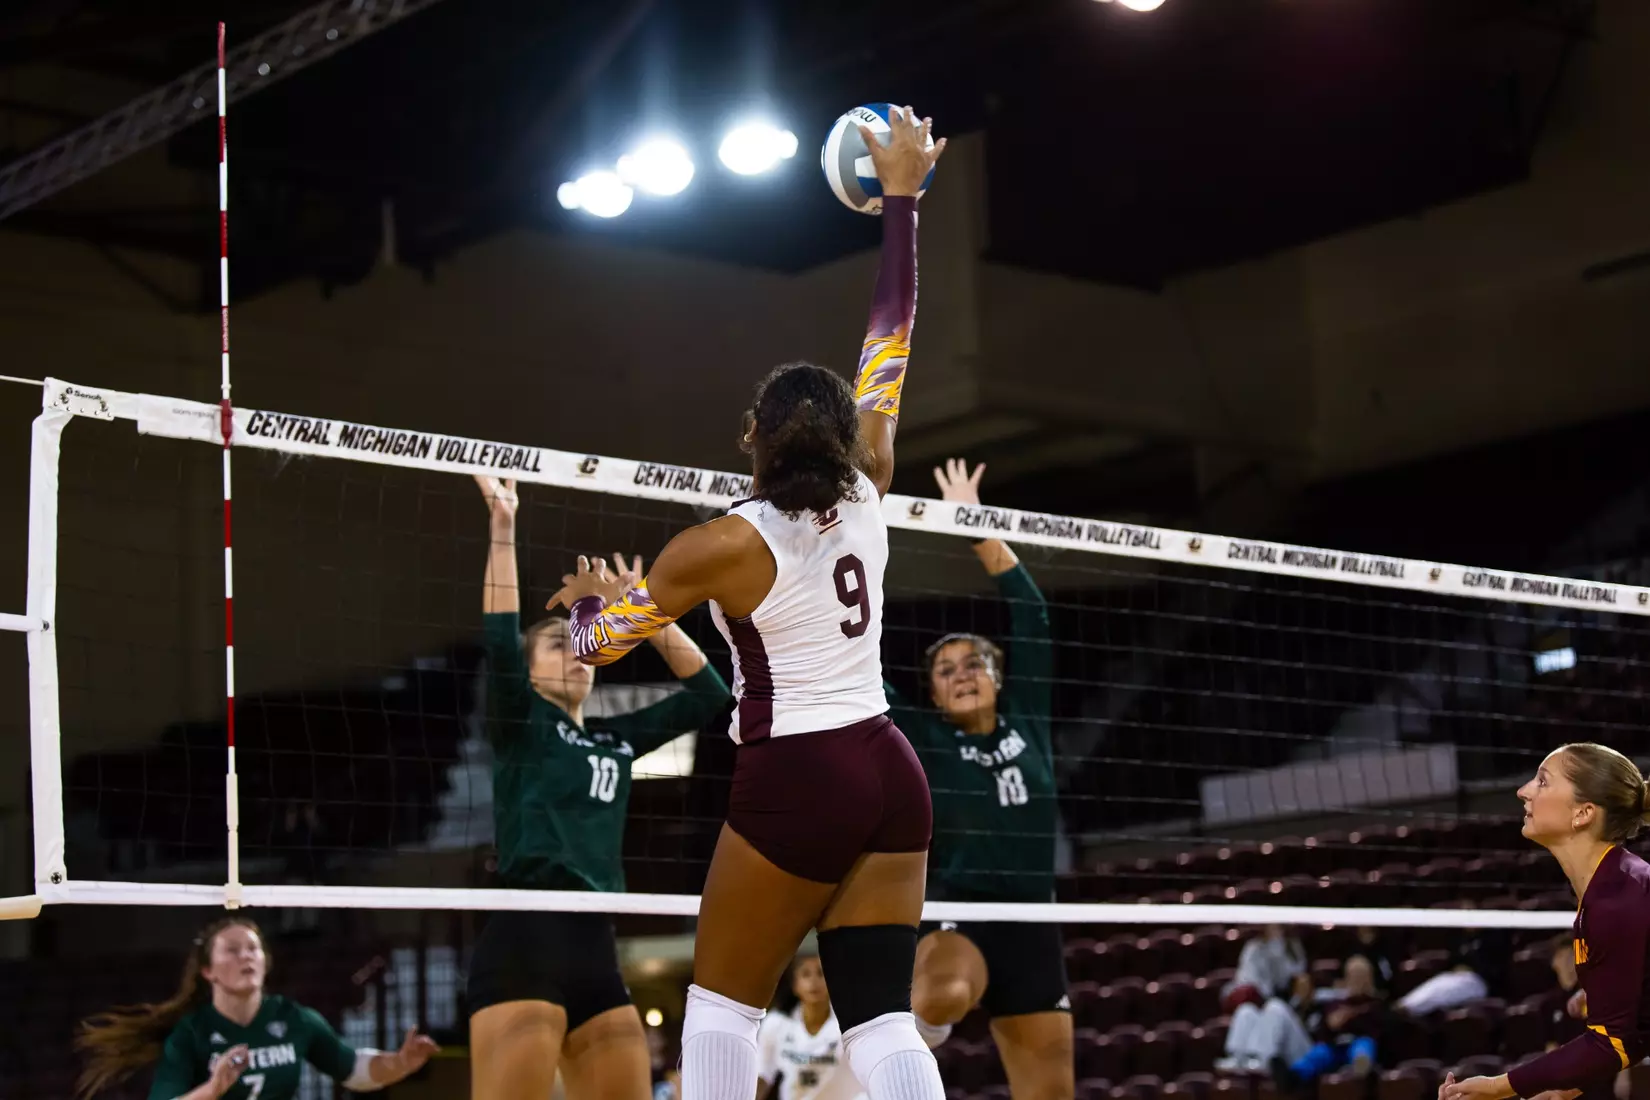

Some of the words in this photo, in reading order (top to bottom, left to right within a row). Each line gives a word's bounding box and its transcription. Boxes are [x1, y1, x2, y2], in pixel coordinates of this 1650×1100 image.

[246, 410, 332, 446] CENTRAL
[336, 423, 432, 459] MICHIGAN
[435, 438, 541, 473] VOLLEYBALL
[633, 463, 703, 492] CENTRAL
[707, 473, 754, 498] MICHI
[955, 506, 1012, 531] CENTRAL
[1018, 515, 1082, 539] MICHIGAN
[1086, 524, 1161, 550] VOLLEYBALL
[1228, 542, 1277, 564] CENTRAL
[1282, 549, 1337, 569] MICHIGAN
[1341, 556, 1405, 579] VOLLEYBALL
[833, 553, 870, 639] 9
[1462, 572, 1506, 591] CENTRAL
[1510, 578, 1559, 596] MICHIGAN
[1562, 584, 1617, 604] VOLLEYBALL
[587, 754, 619, 803] 10
[241, 1073, 265, 1100] 7
